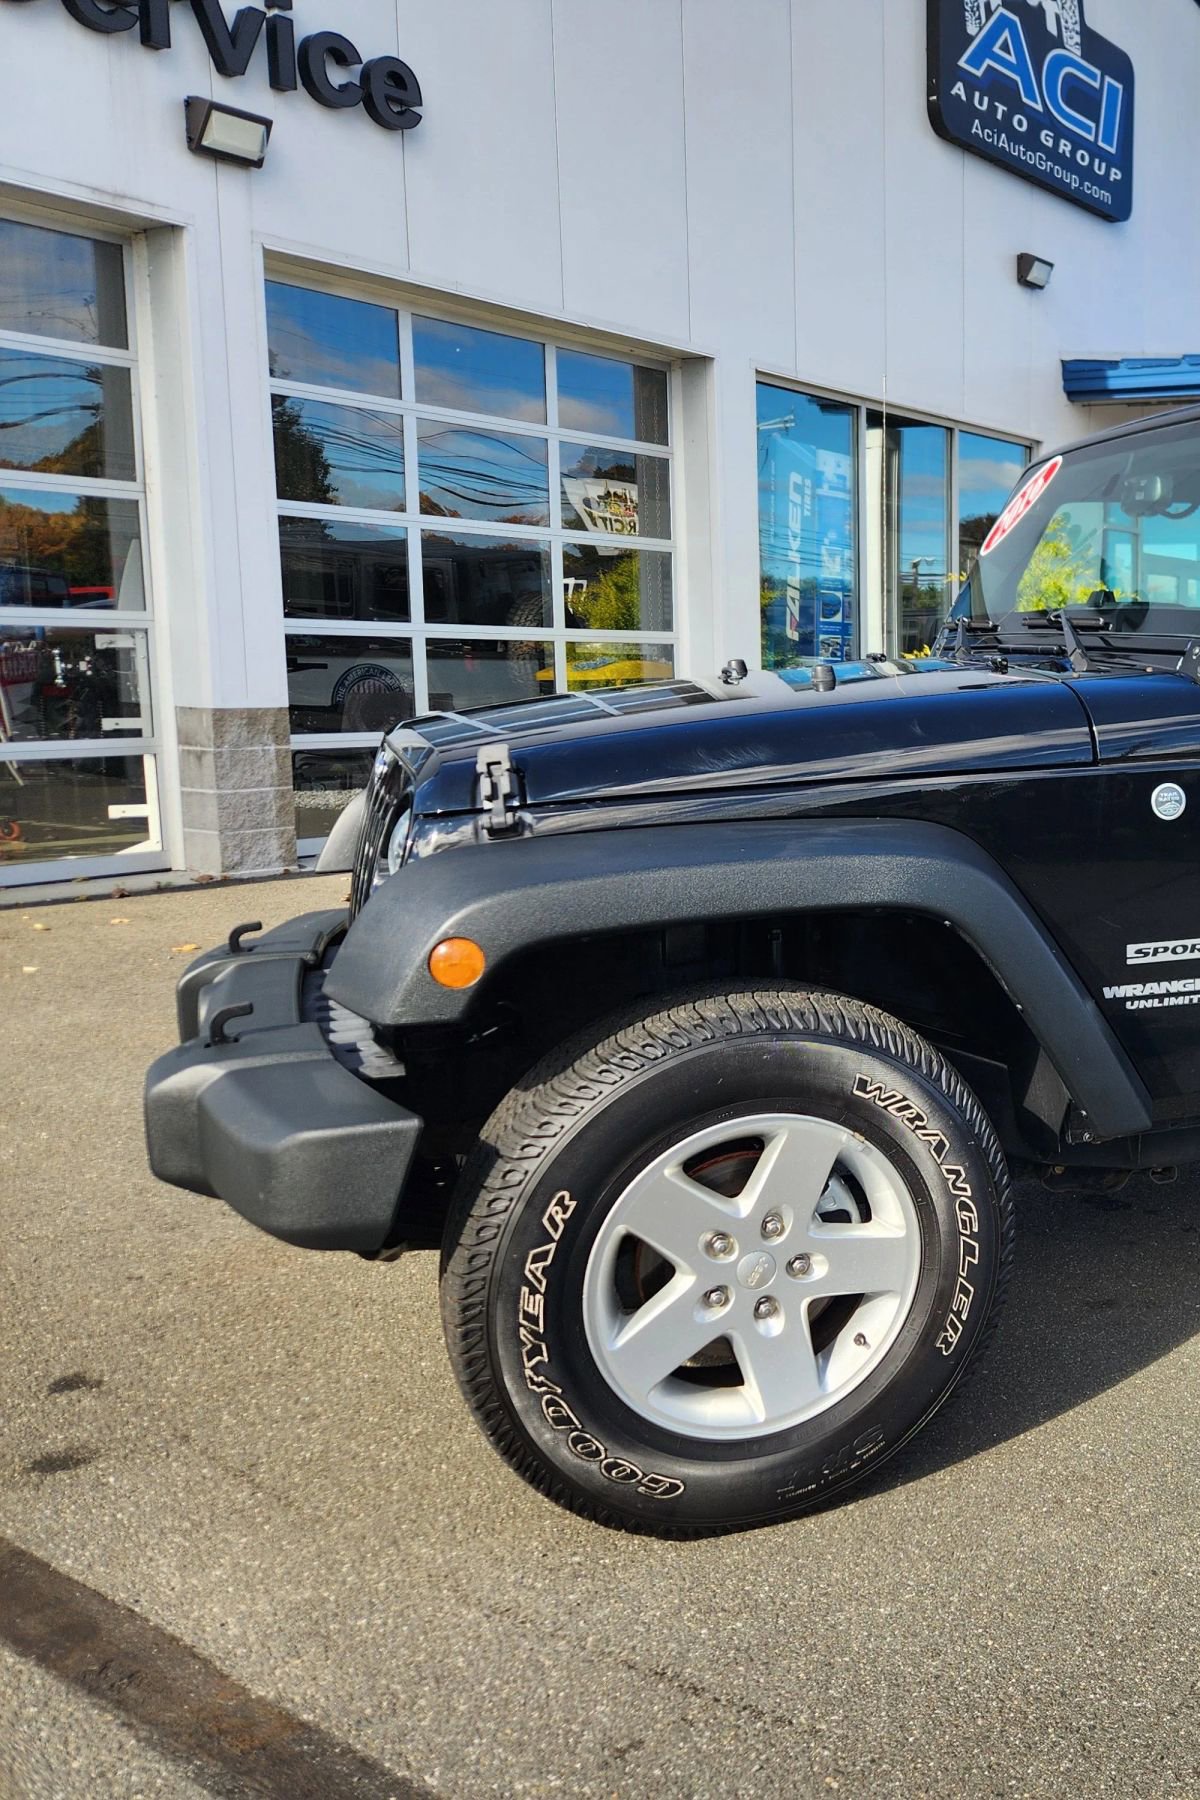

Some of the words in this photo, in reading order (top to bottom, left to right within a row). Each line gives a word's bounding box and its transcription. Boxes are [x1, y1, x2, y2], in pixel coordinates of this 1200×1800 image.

[0, 0, 422, 130] rvice
[951, 82, 1028, 132] AUTO
[1040, 130, 1122, 182] GROUP
[957, 6, 1123, 155] ACI
[971, 119, 1112, 204] AciAutoGroup.com
[786, 472, 802, 641] FALKEN
[803, 479, 812, 517] TIRES
[852, 1072, 979, 1356] WRANGLER
[519, 1190, 685, 1499] GOODYEAR
